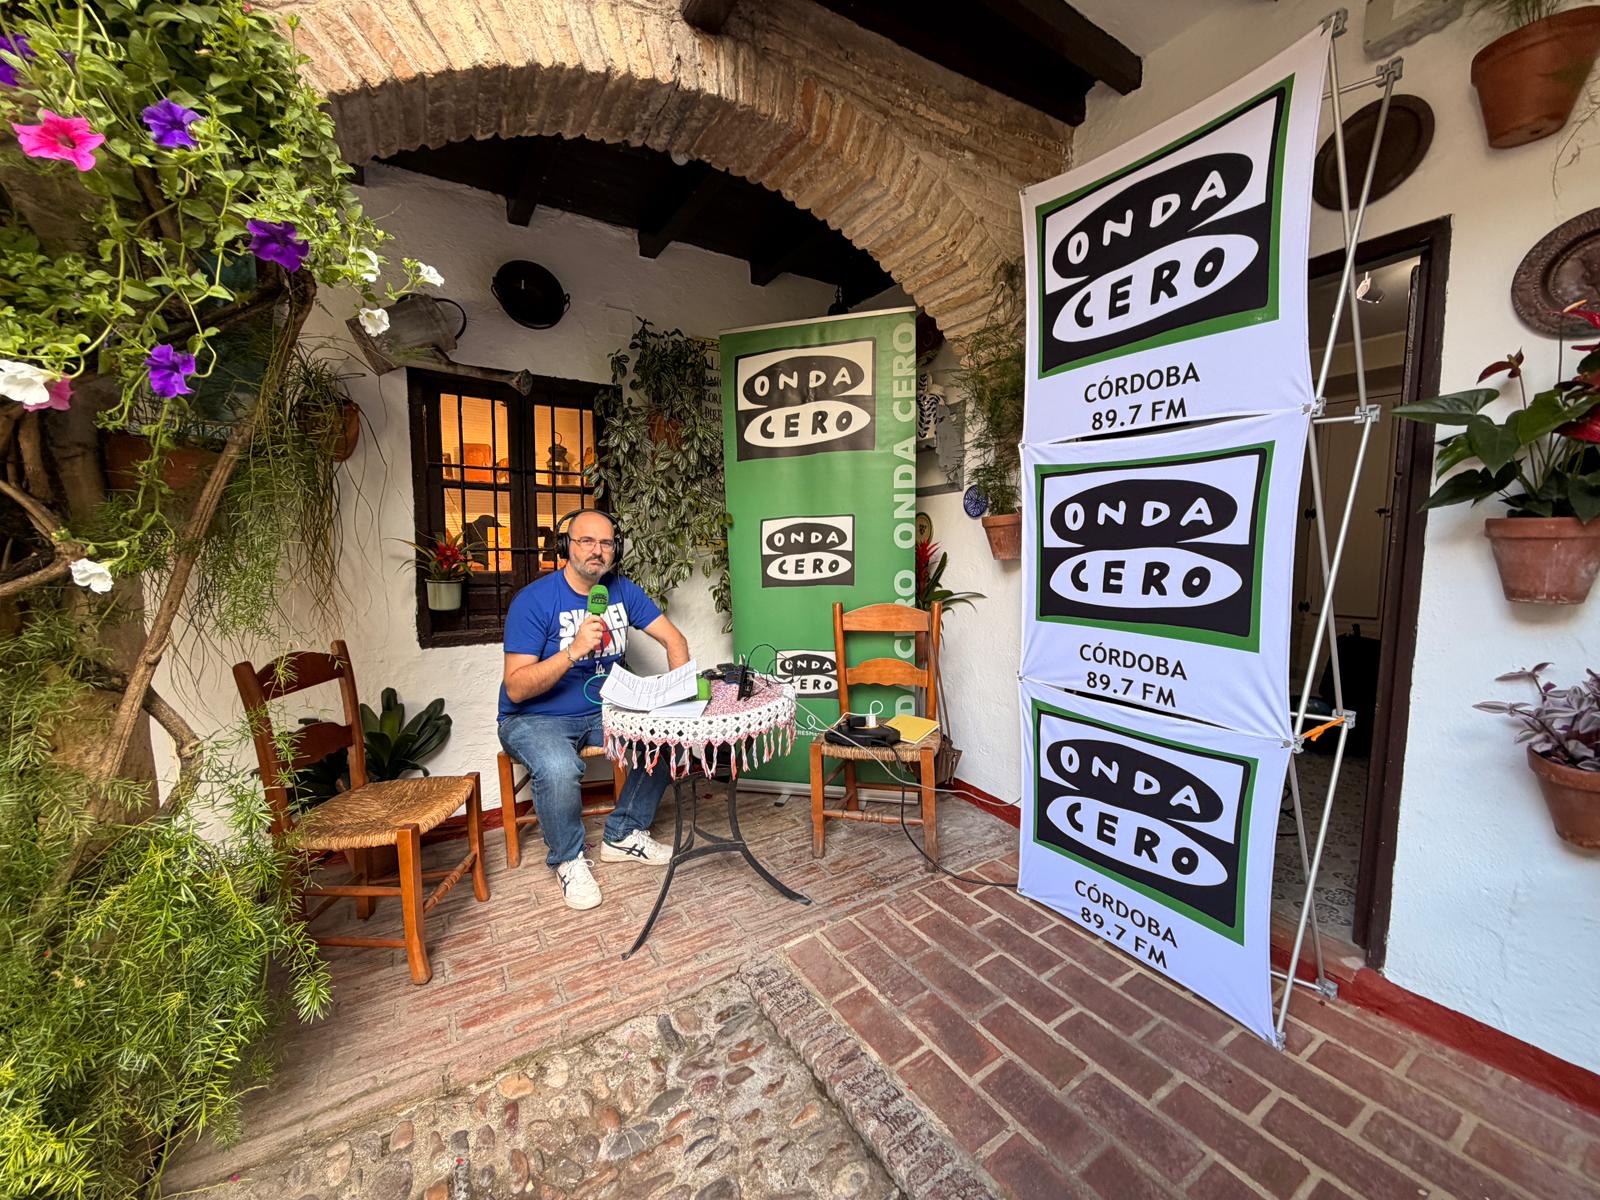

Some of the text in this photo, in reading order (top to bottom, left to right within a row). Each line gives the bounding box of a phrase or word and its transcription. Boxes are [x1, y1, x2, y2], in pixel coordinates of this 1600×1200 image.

[1068, 170, 1227, 264] ONDA
[1075, 247, 1225, 328] CERO
[754, 366, 852, 396] ONDA
[892, 322, 916, 423] CERO
[1084, 362, 1200, 403] CÓRDOBA
[760, 410, 853, 439] CERO
[1091, 397, 1187, 431] 89.7 FM
[893, 436, 916, 550] ONDA
[1064, 497, 1213, 531] ONDA
[773, 531, 839, 547] ONDA
[777, 558, 840, 574] CERO
[1070, 559, 1212, 598] CERO
[784, 659, 832, 670] ONDA
[1079, 642, 1188, 681] CÓRDOBA
[793, 678, 833, 690] ERO
[1086, 671, 1176, 708] 89.7 FM
[1060, 745, 1201, 814] ONDA
[1066, 802, 1199, 875] CERO
[1074, 879, 1178, 948] CÓRDOBA
[1081, 907, 1168, 969] 89.7 FM
